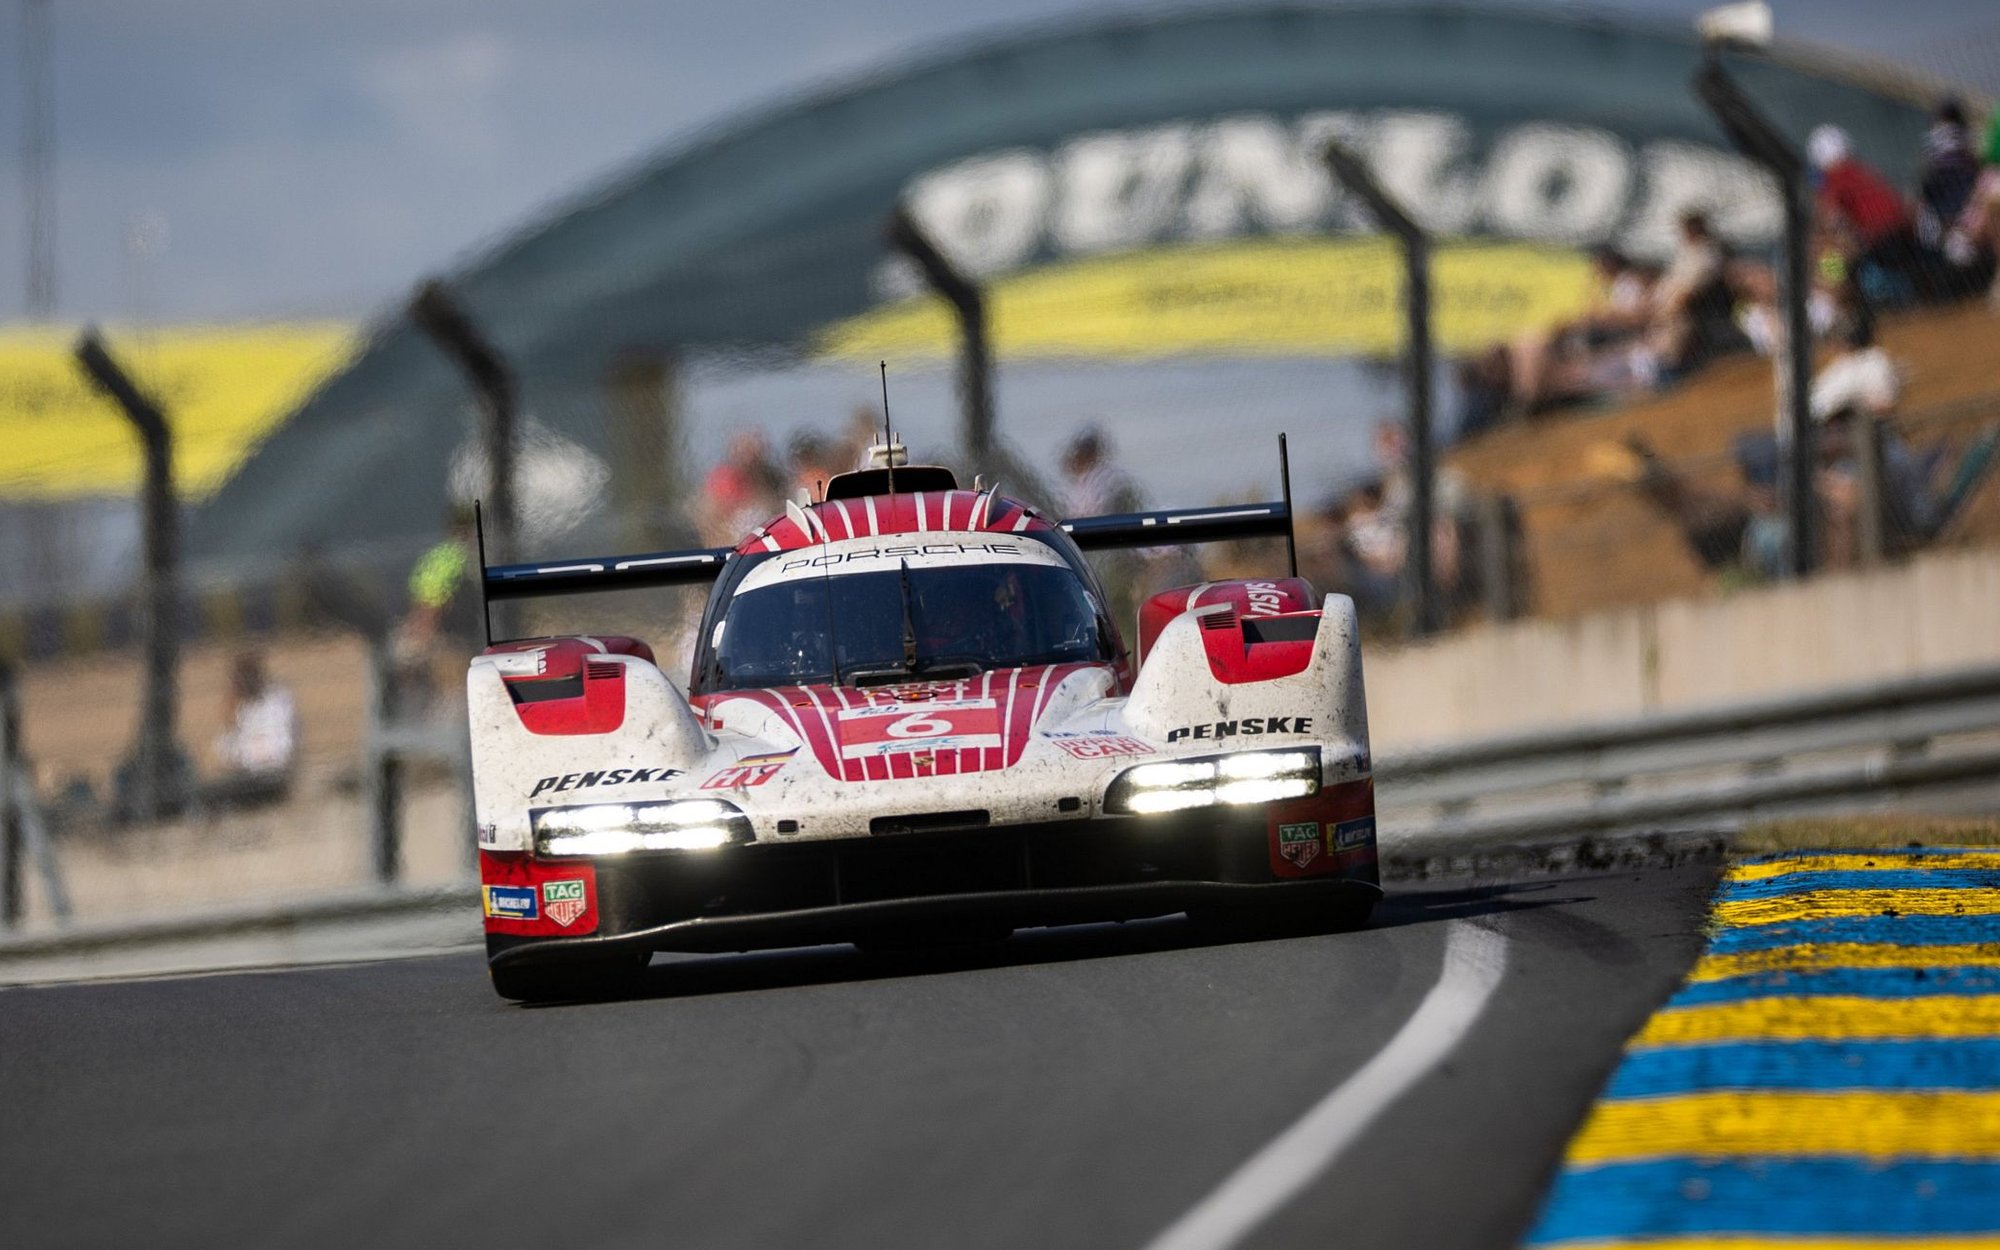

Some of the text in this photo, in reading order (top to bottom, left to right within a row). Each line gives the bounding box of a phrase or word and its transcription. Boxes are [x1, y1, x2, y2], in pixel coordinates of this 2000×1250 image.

[782, 544, 1021, 573] PORSCHE
[886, 712, 953, 738] 6
[1168, 717, 1313, 743] PENSKE
[1072, 743, 1149, 757] CAR
[529, 768, 686, 798] PENSKE
[704, 764, 782, 788] HY
[1283, 826, 1316, 840] TAG
[546, 884, 581, 899] TAG
[546, 901, 584, 924] HEUER
